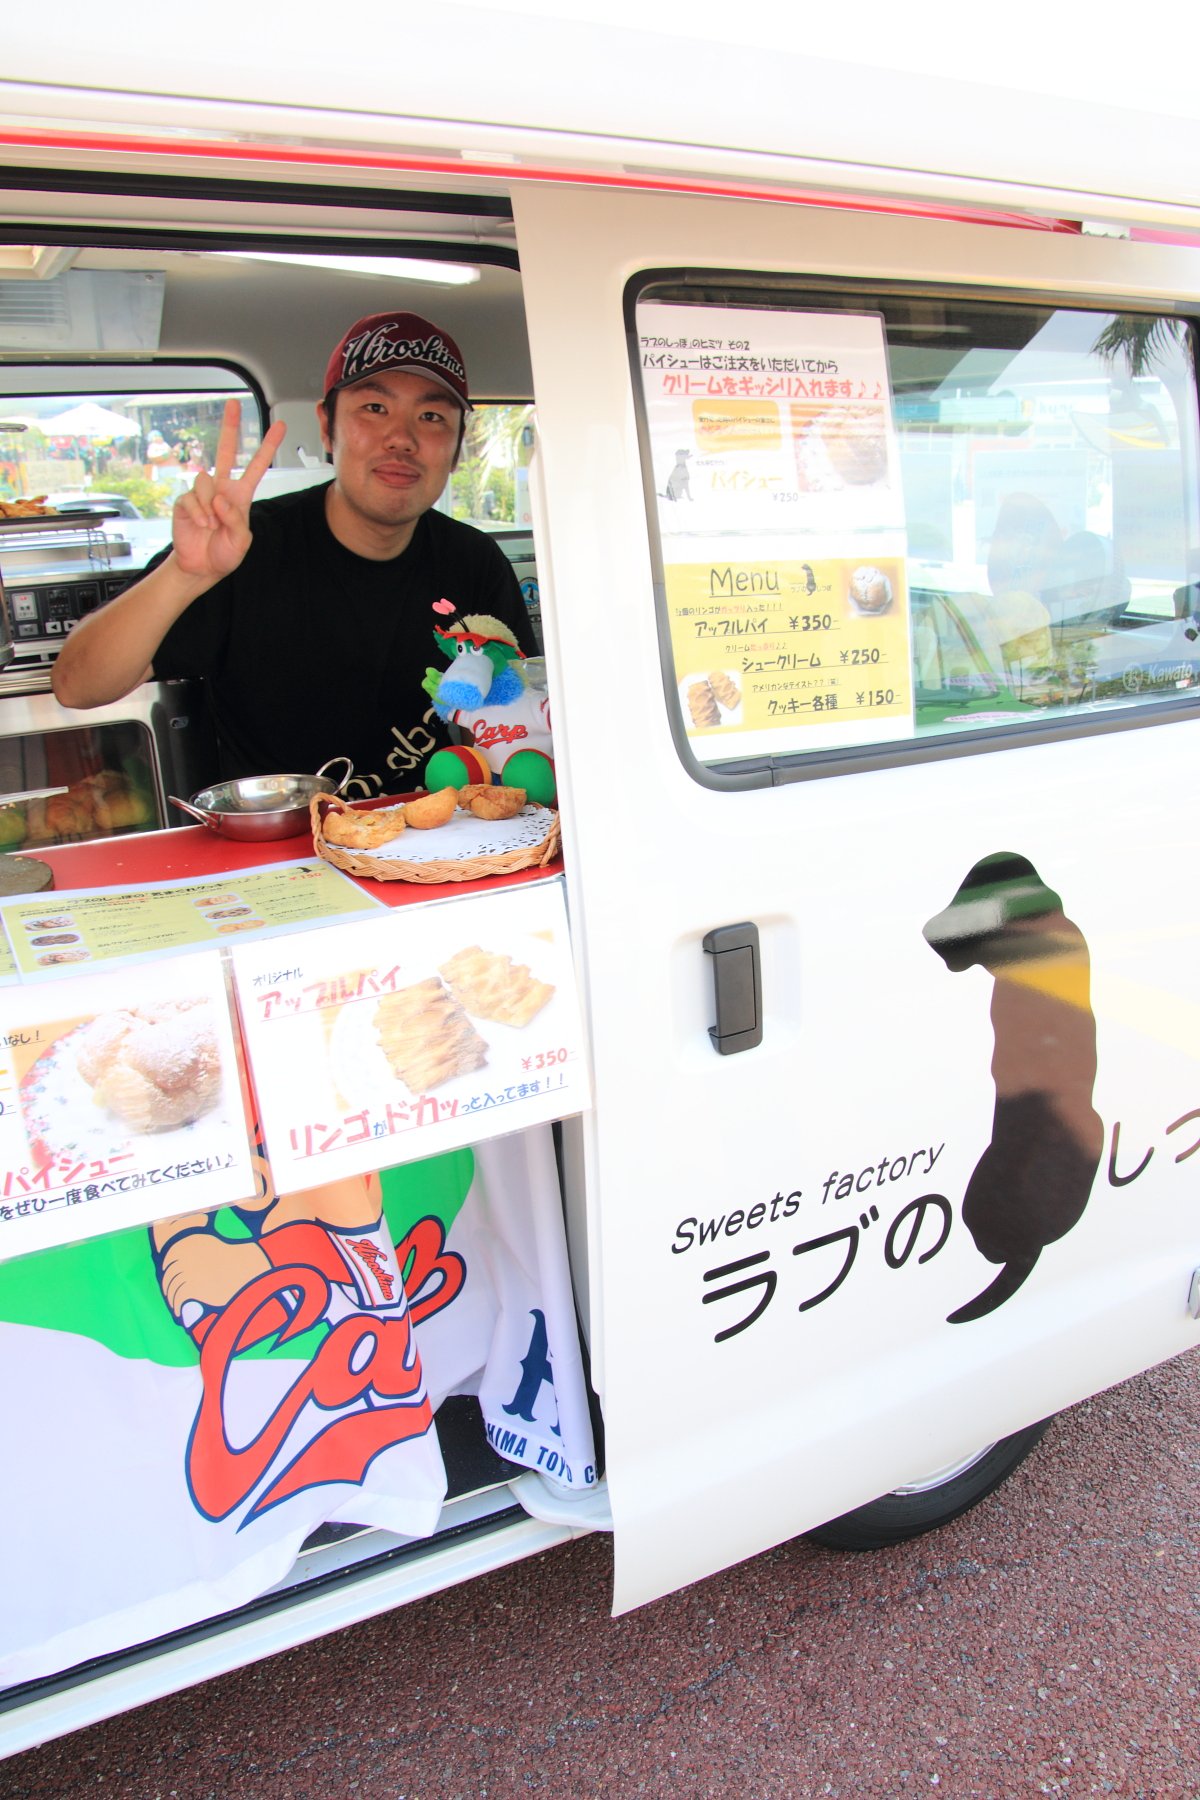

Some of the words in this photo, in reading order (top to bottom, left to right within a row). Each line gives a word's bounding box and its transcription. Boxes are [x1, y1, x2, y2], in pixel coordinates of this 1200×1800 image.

[643, 354, 839, 373] パイシューはご注文をいただいてから
[711, 469, 784, 490] パイシュー
[710, 567, 779, 596] Menu
[695, 617, 768, 636] アップルパイ
[742, 652, 821, 672] シュークリーム
[768, 694, 838, 715] クッキー各種
[473, 719, 528, 748] Carp
[253, 967, 303, 986] オリジナル
[257, 965, 402, 1018] アップルパイ
[4, 1152, 135, 1197] パイシュー
[671, 1184, 803, 1255] Sweets
[821, 1142, 946, 1204] factory
[701, 1193, 954, 1344] ラブの
